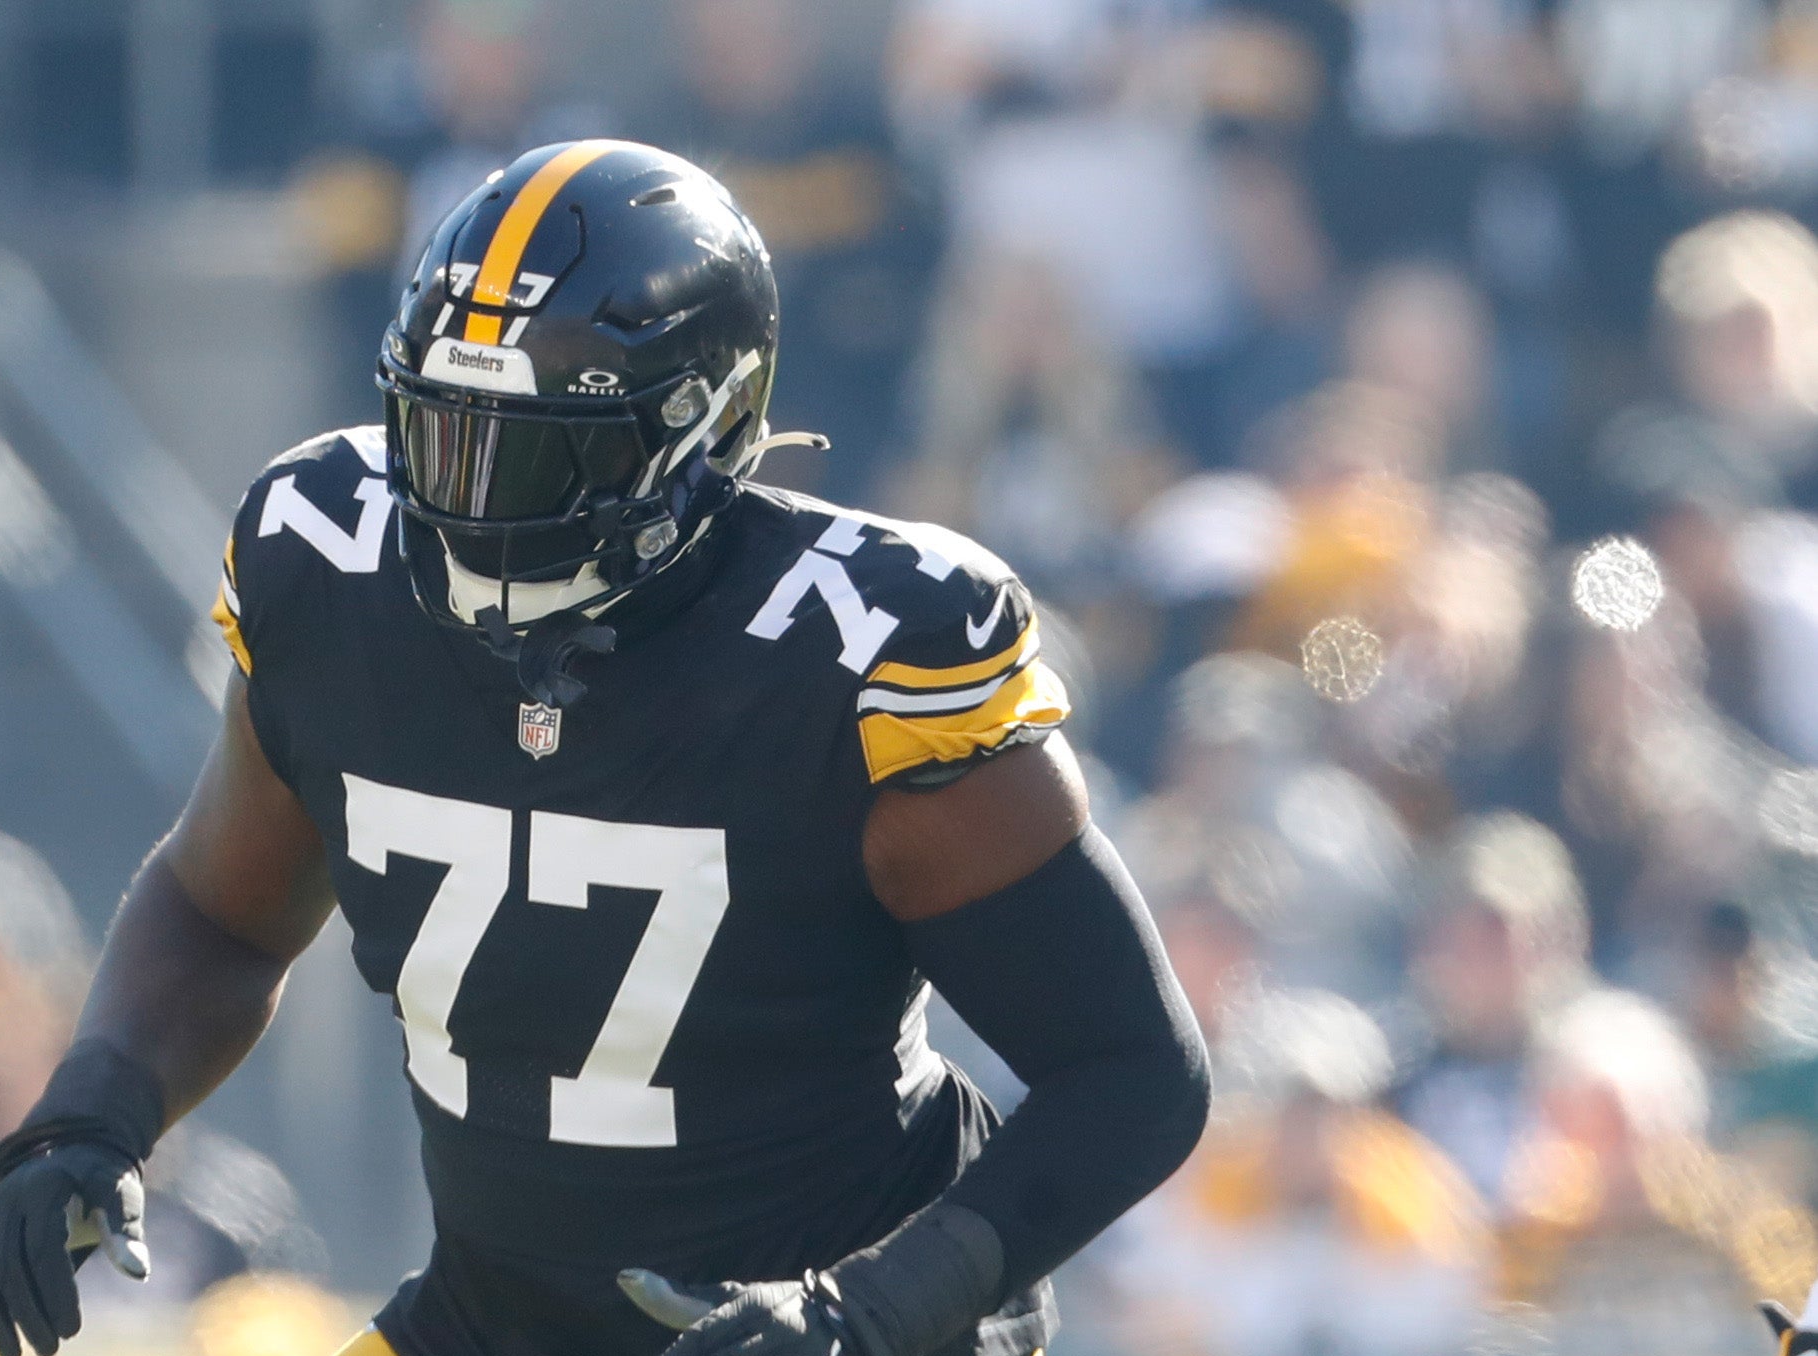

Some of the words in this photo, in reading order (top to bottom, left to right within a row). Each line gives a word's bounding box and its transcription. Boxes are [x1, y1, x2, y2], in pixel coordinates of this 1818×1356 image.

[432, 262, 556, 347] 77
[447, 345, 505, 373] Steelers
[566, 383, 627, 397] OAKLEY
[524, 723, 553, 750] NFL
[340, 771, 731, 1148] 77
